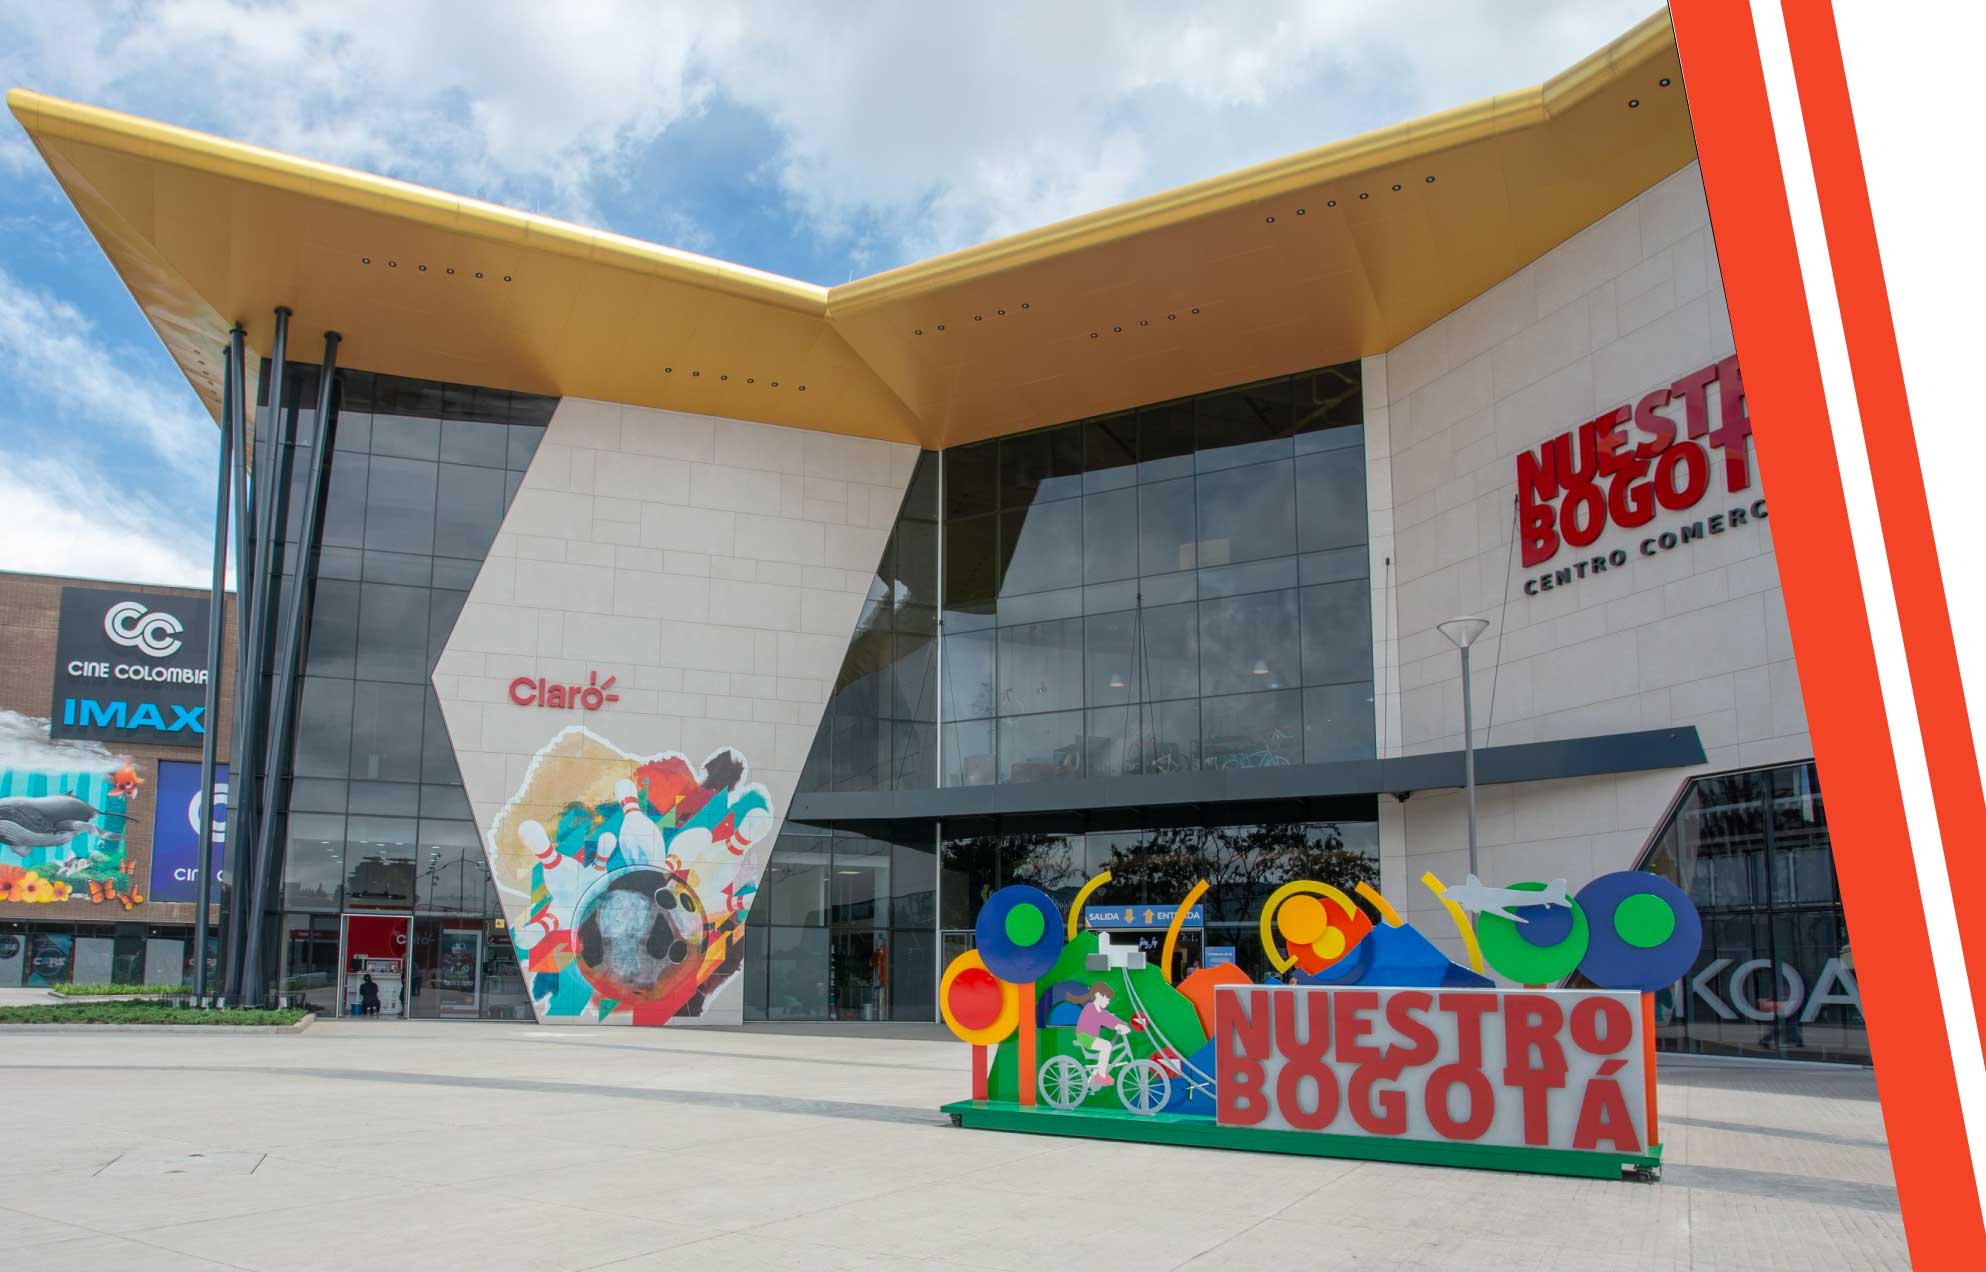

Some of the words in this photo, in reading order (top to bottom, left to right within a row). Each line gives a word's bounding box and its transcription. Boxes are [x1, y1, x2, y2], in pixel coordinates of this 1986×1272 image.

[1524, 550, 1626, 596] CENTRO
[68, 661, 109, 678] CINE
[509, 673, 612, 710] Claro
[63, 698, 206, 733] IMAX
[1088, 912, 1120, 921] SALIDA
[1157, 911, 1200, 920] ENTDA
[1215, 989, 1633, 1074] NUESTRO
[1216, 1058, 1642, 1153] BOGOTÁ
